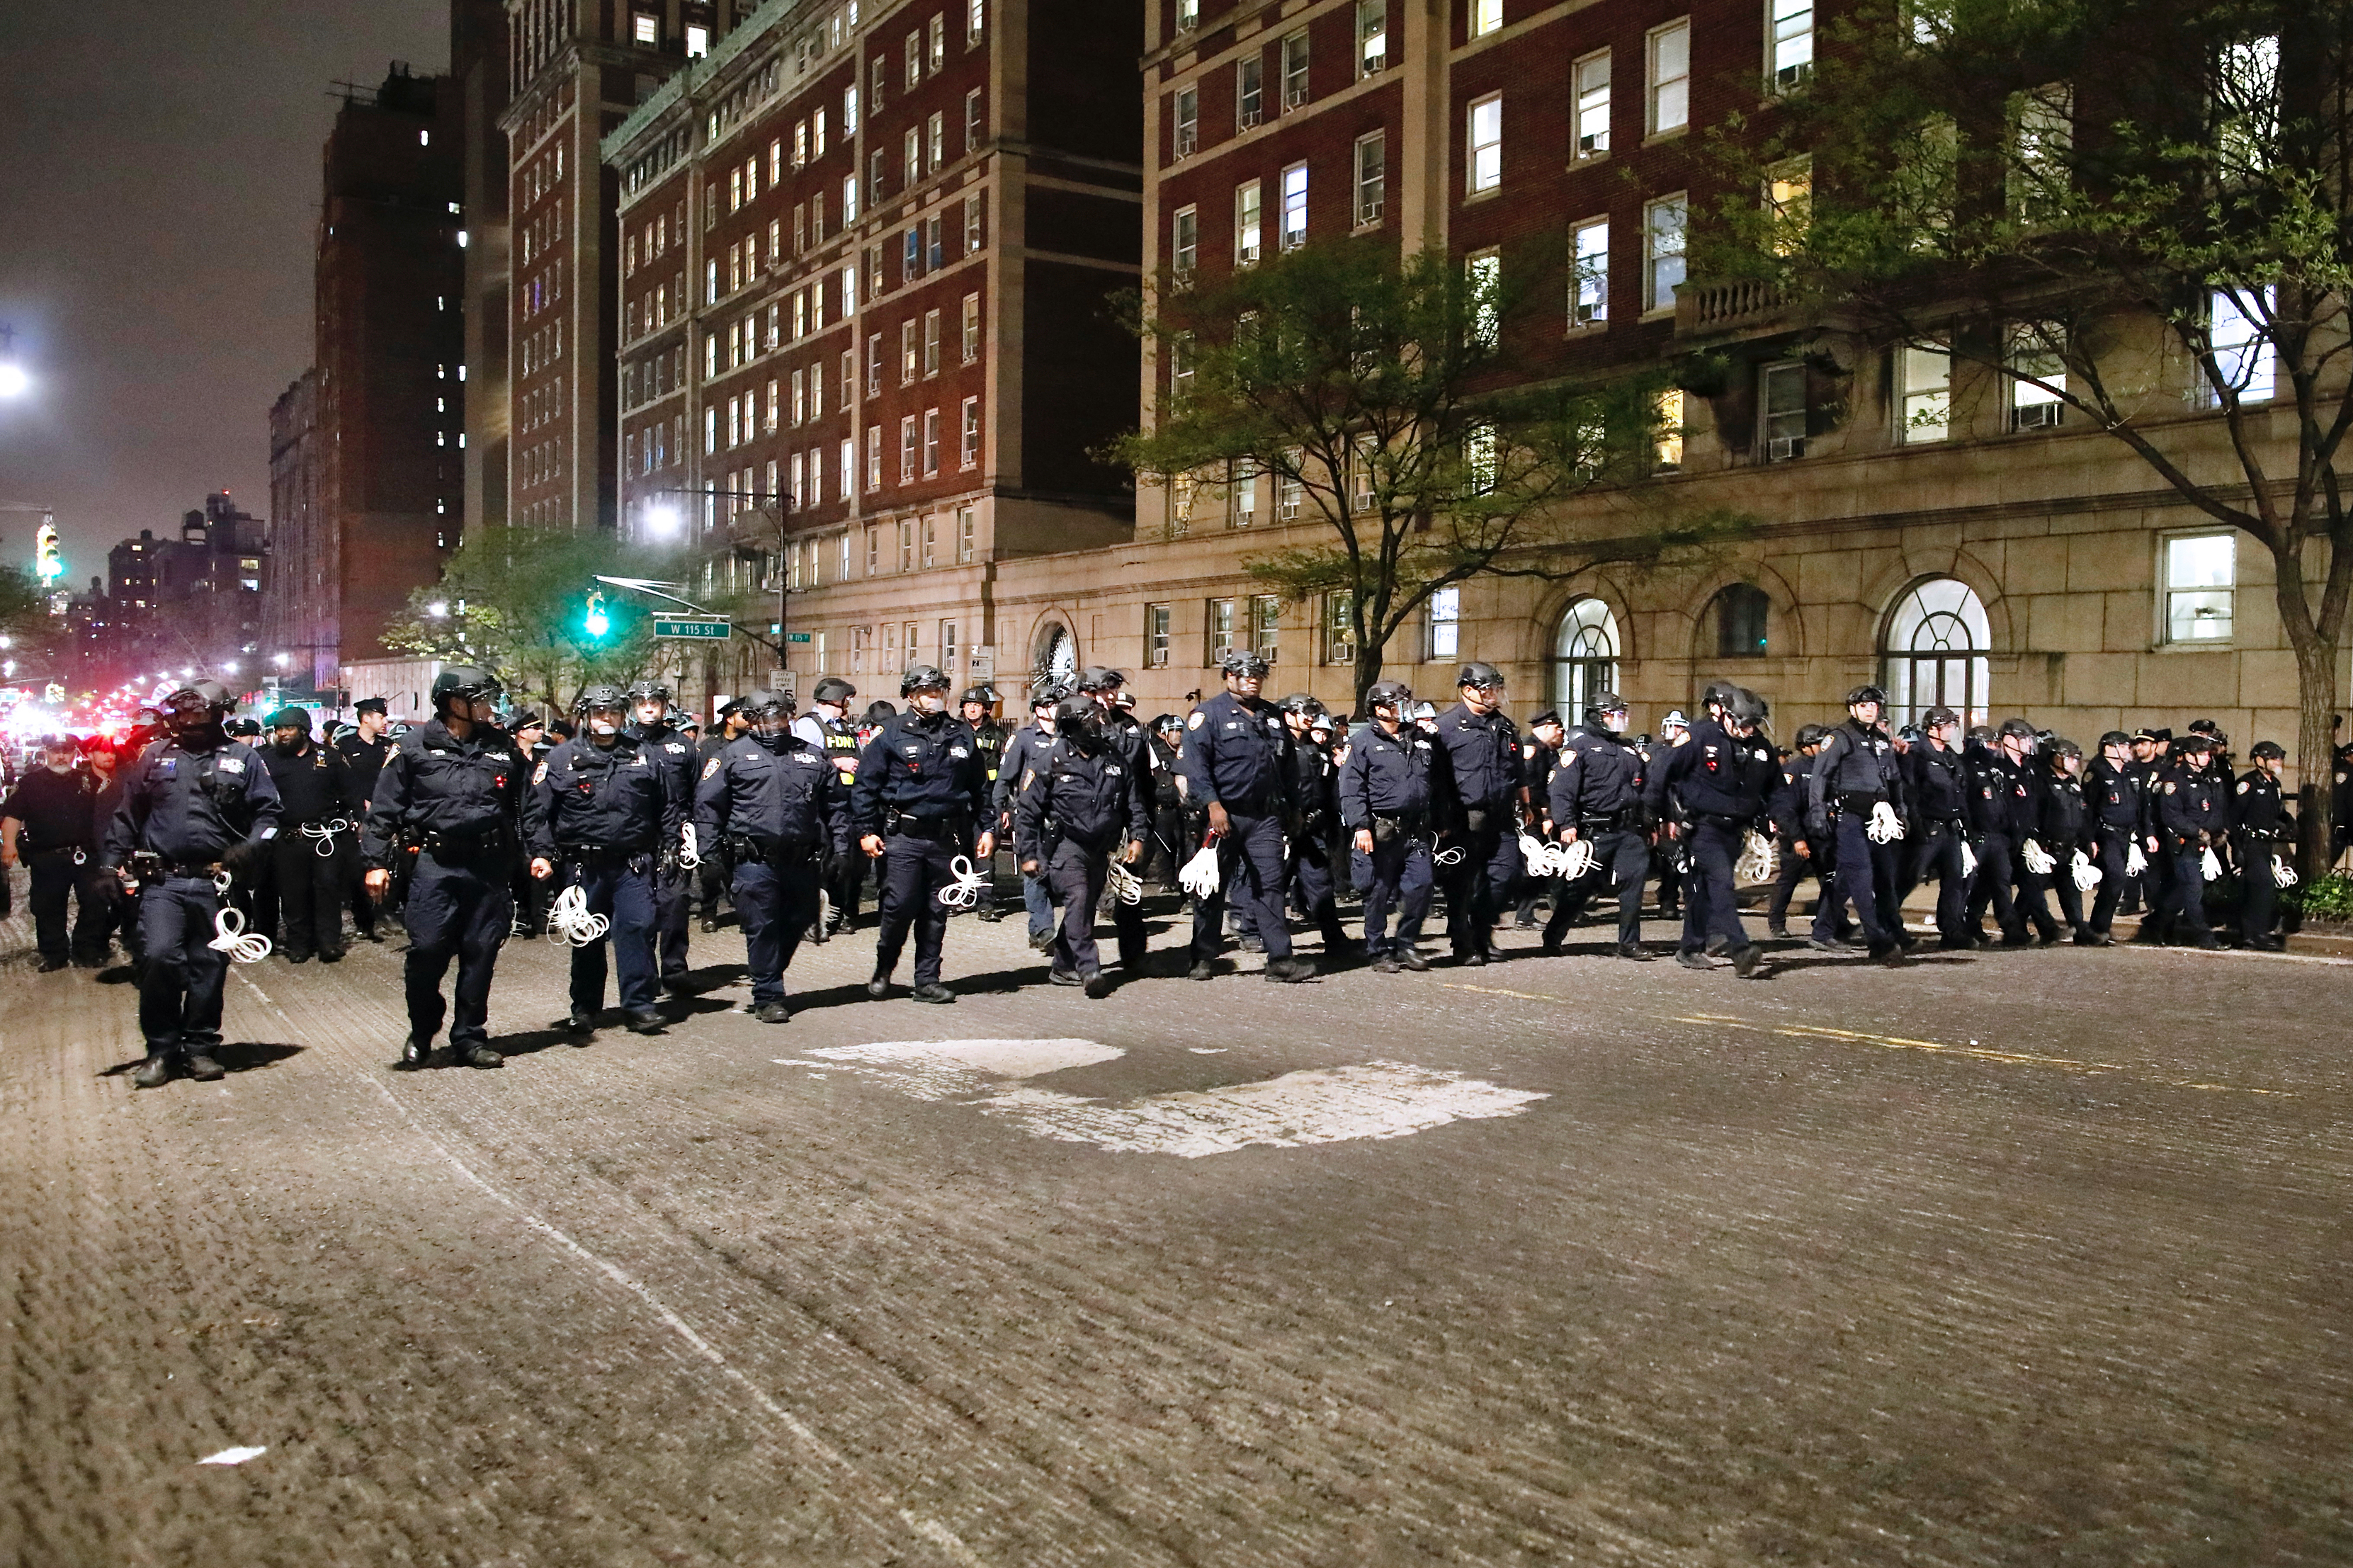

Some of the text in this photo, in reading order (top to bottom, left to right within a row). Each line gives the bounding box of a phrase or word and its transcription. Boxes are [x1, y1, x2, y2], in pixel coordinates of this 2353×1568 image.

[671, 625, 714, 635] W 115 St
